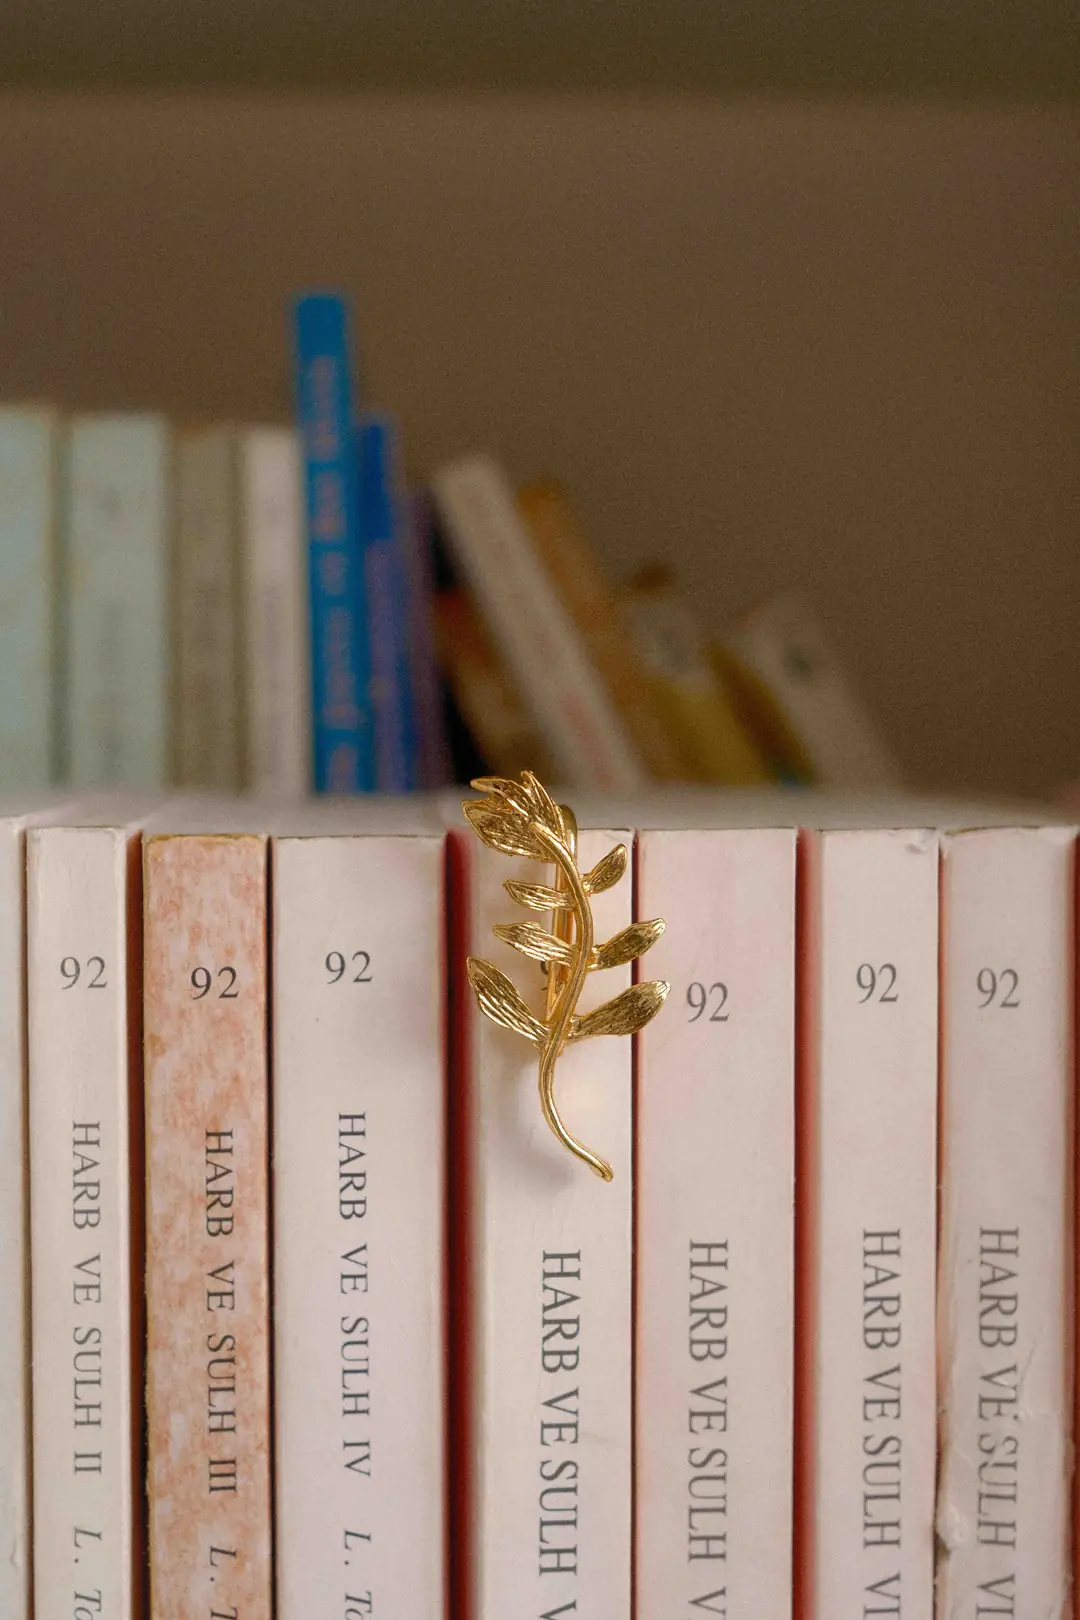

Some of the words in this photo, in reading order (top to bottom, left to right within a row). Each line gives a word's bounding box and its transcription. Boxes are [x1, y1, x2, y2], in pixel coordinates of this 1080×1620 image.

[59, 956, 108, 990] 92
[191, 965, 240, 1001] 92
[325, 950, 373, 985] 92
[855, 963, 899, 1004] 92
[976, 968, 1020, 1009] 92
[685, 981, 730, 1023] 92
[72, 1121, 101, 1230] HARB
[205, 1127, 234, 1238] HARB
[338, 1111, 367, 1221] HARB
[73, 1253, 102, 1305] VE
[206, 1259, 236, 1313] VE
[340, 1243, 369, 1295] VE
[863, 1228, 901, 1350] HARB
[979, 1227, 1019, 1348] HARB
[541, 1249, 581, 1374] HARB
[688, 1239, 729, 1362] HARB
[73, 1326, 102, 1429] SULH
[206, 1332, 237, 1435] SULH
[340, 1315, 370, 1417] SULH
[863, 1364, 901, 1422] VE
[978, 1363, 1019, 1421] VE
[540, 1386, 580, 1447] VE
[688, 1375, 728, 1435] VE
[74, 1451, 102, 1475] II
[208, 1456, 238, 1494] III
[342, 1440, 372, 1477] IV
[538, 1459, 579, 1577] SULH
[687, 1447, 728, 1563] SULH
[862, 1434, 902, 1548] SULH
[977, 1433, 1019, 1550] SULH
[74, 1526, 102, 1564] L.
[209, 1545, 238, 1582] L.
[343, 1528, 372, 1566] L.
[687, 1586, 727, 1620] V
